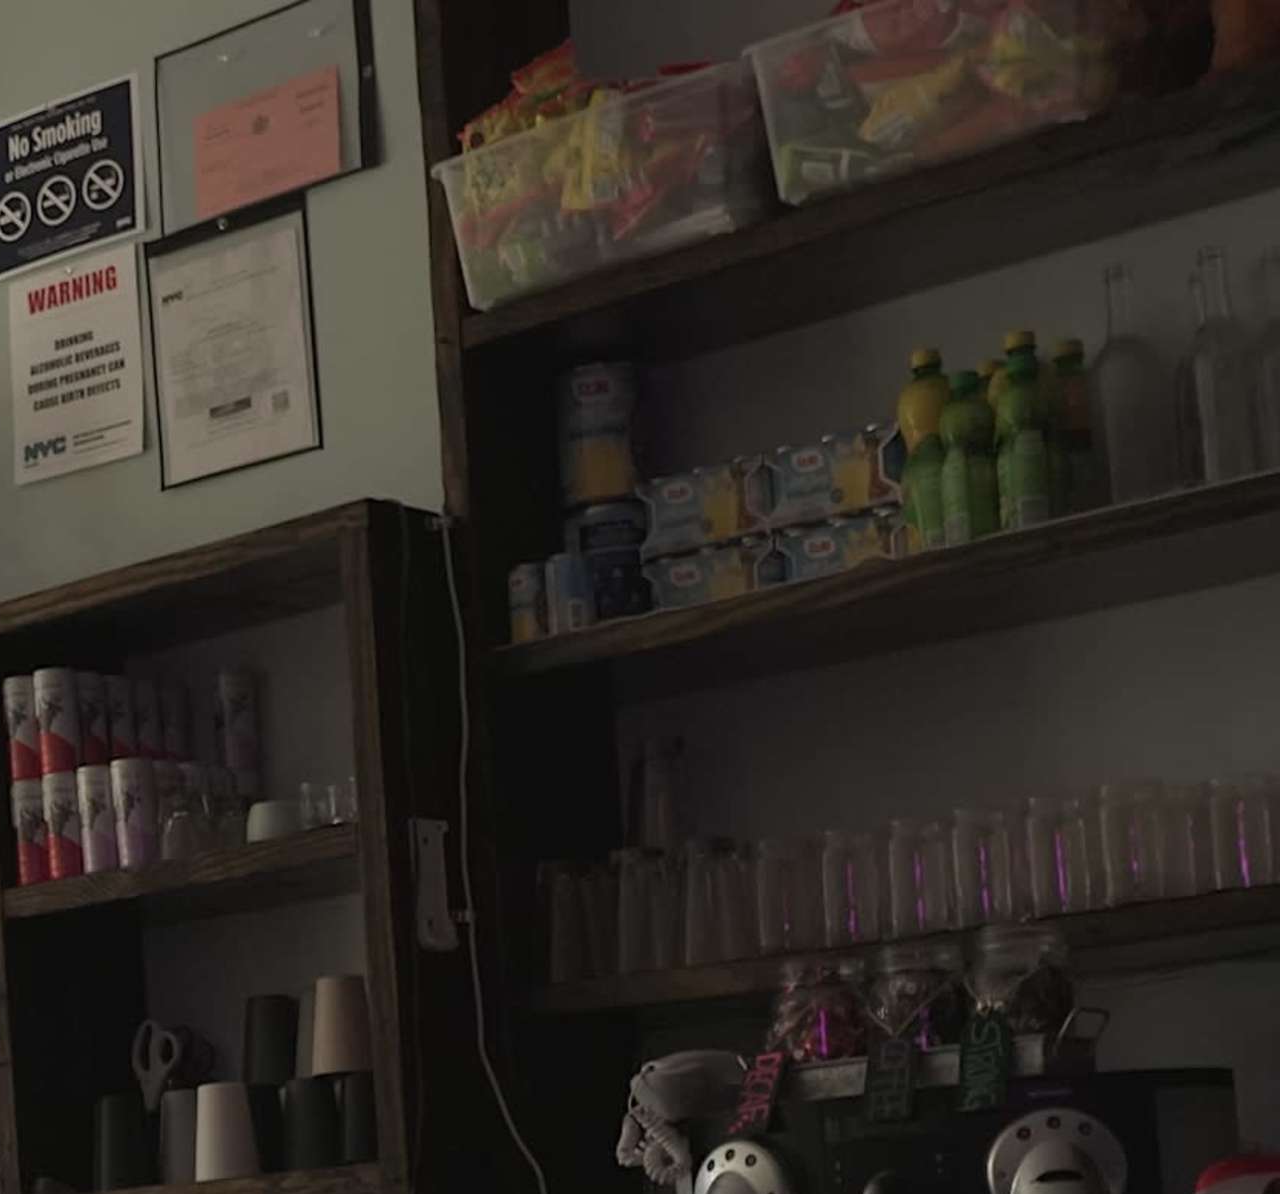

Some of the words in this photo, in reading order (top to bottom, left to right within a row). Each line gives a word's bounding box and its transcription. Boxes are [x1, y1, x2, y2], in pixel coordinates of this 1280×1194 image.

[7, 133, 30, 162] No
[31, 110, 102, 152] Smoking
[27, 265, 118, 315] WARNING
[30, 353, 73, 377] ALCOHOLIC
[75, 341, 121, 363] BEVERAGES
[54, 331, 94, 351] DRINKING
[27, 378, 58, 395] DURING
[59, 363, 107, 389] PREGNANCY
[108, 358, 126, 374] CAN
[33, 394, 60, 412] CAUSE
[61, 387, 86, 405] BIRTH
[87, 378, 121, 398] DEFECTS
[24, 435, 67, 462] NYC
